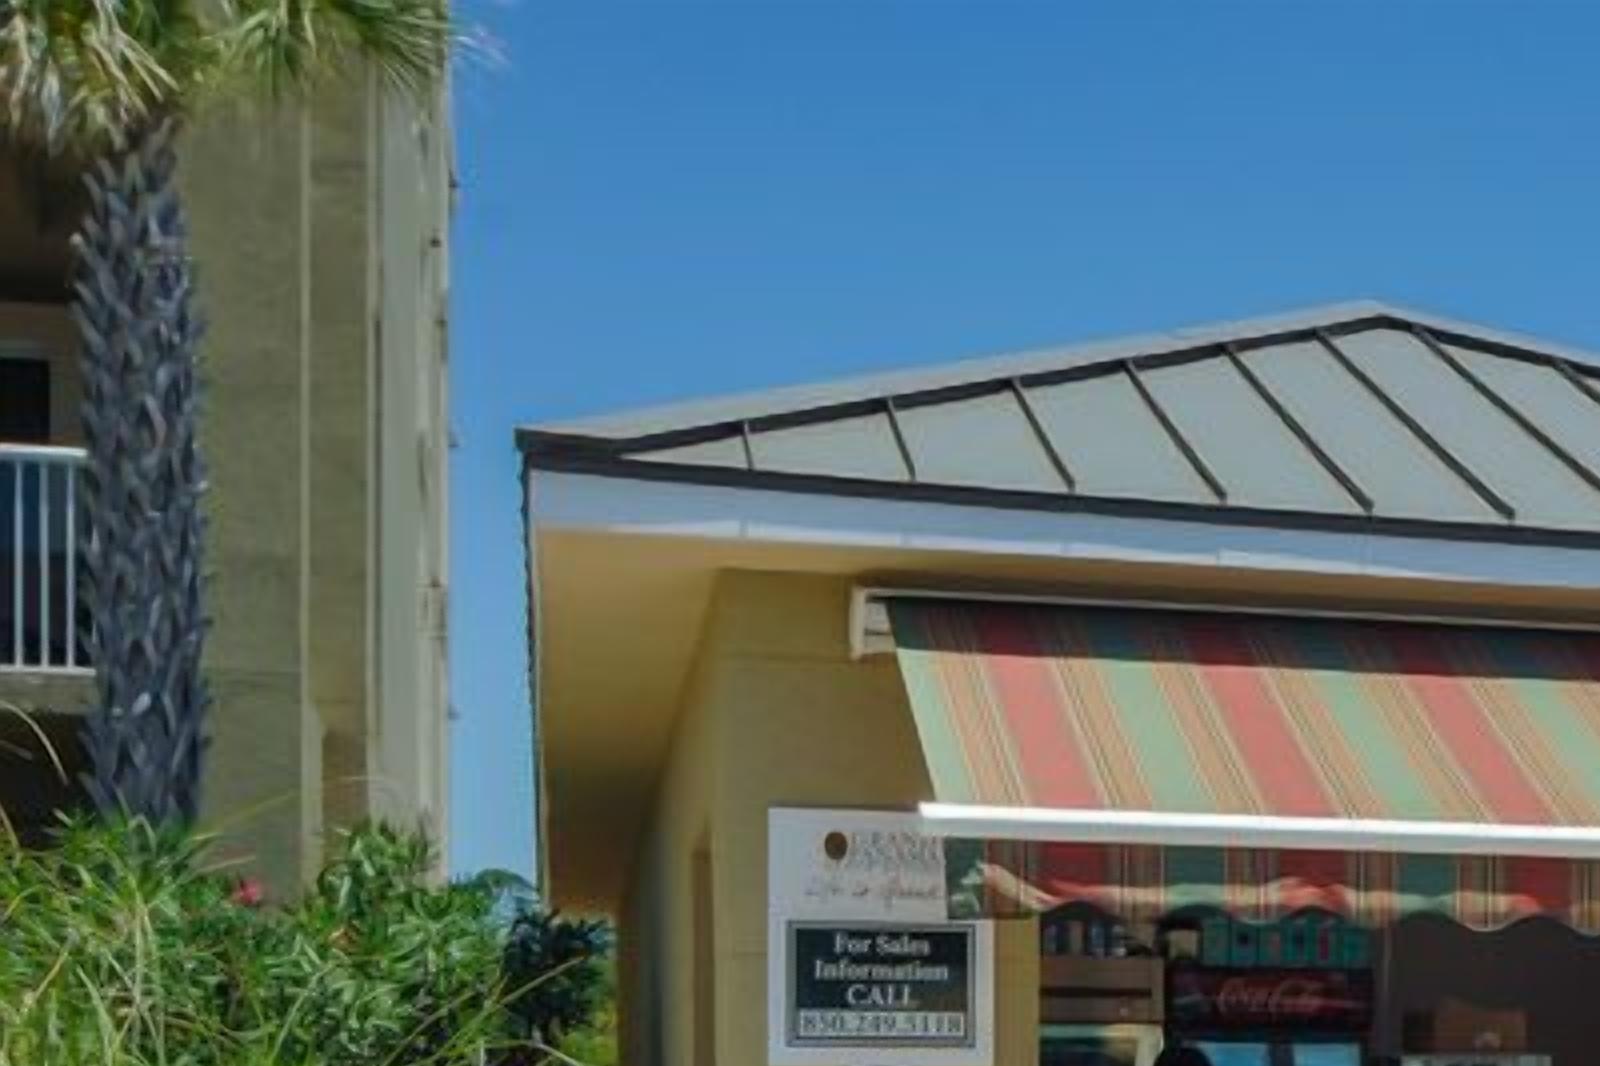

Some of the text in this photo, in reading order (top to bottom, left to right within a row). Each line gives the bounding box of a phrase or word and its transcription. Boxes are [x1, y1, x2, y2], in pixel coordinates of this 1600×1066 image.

[834, 933, 871, 953] For
[815, 960, 948, 980] Information
[846, 984, 913, 1005] CALL
